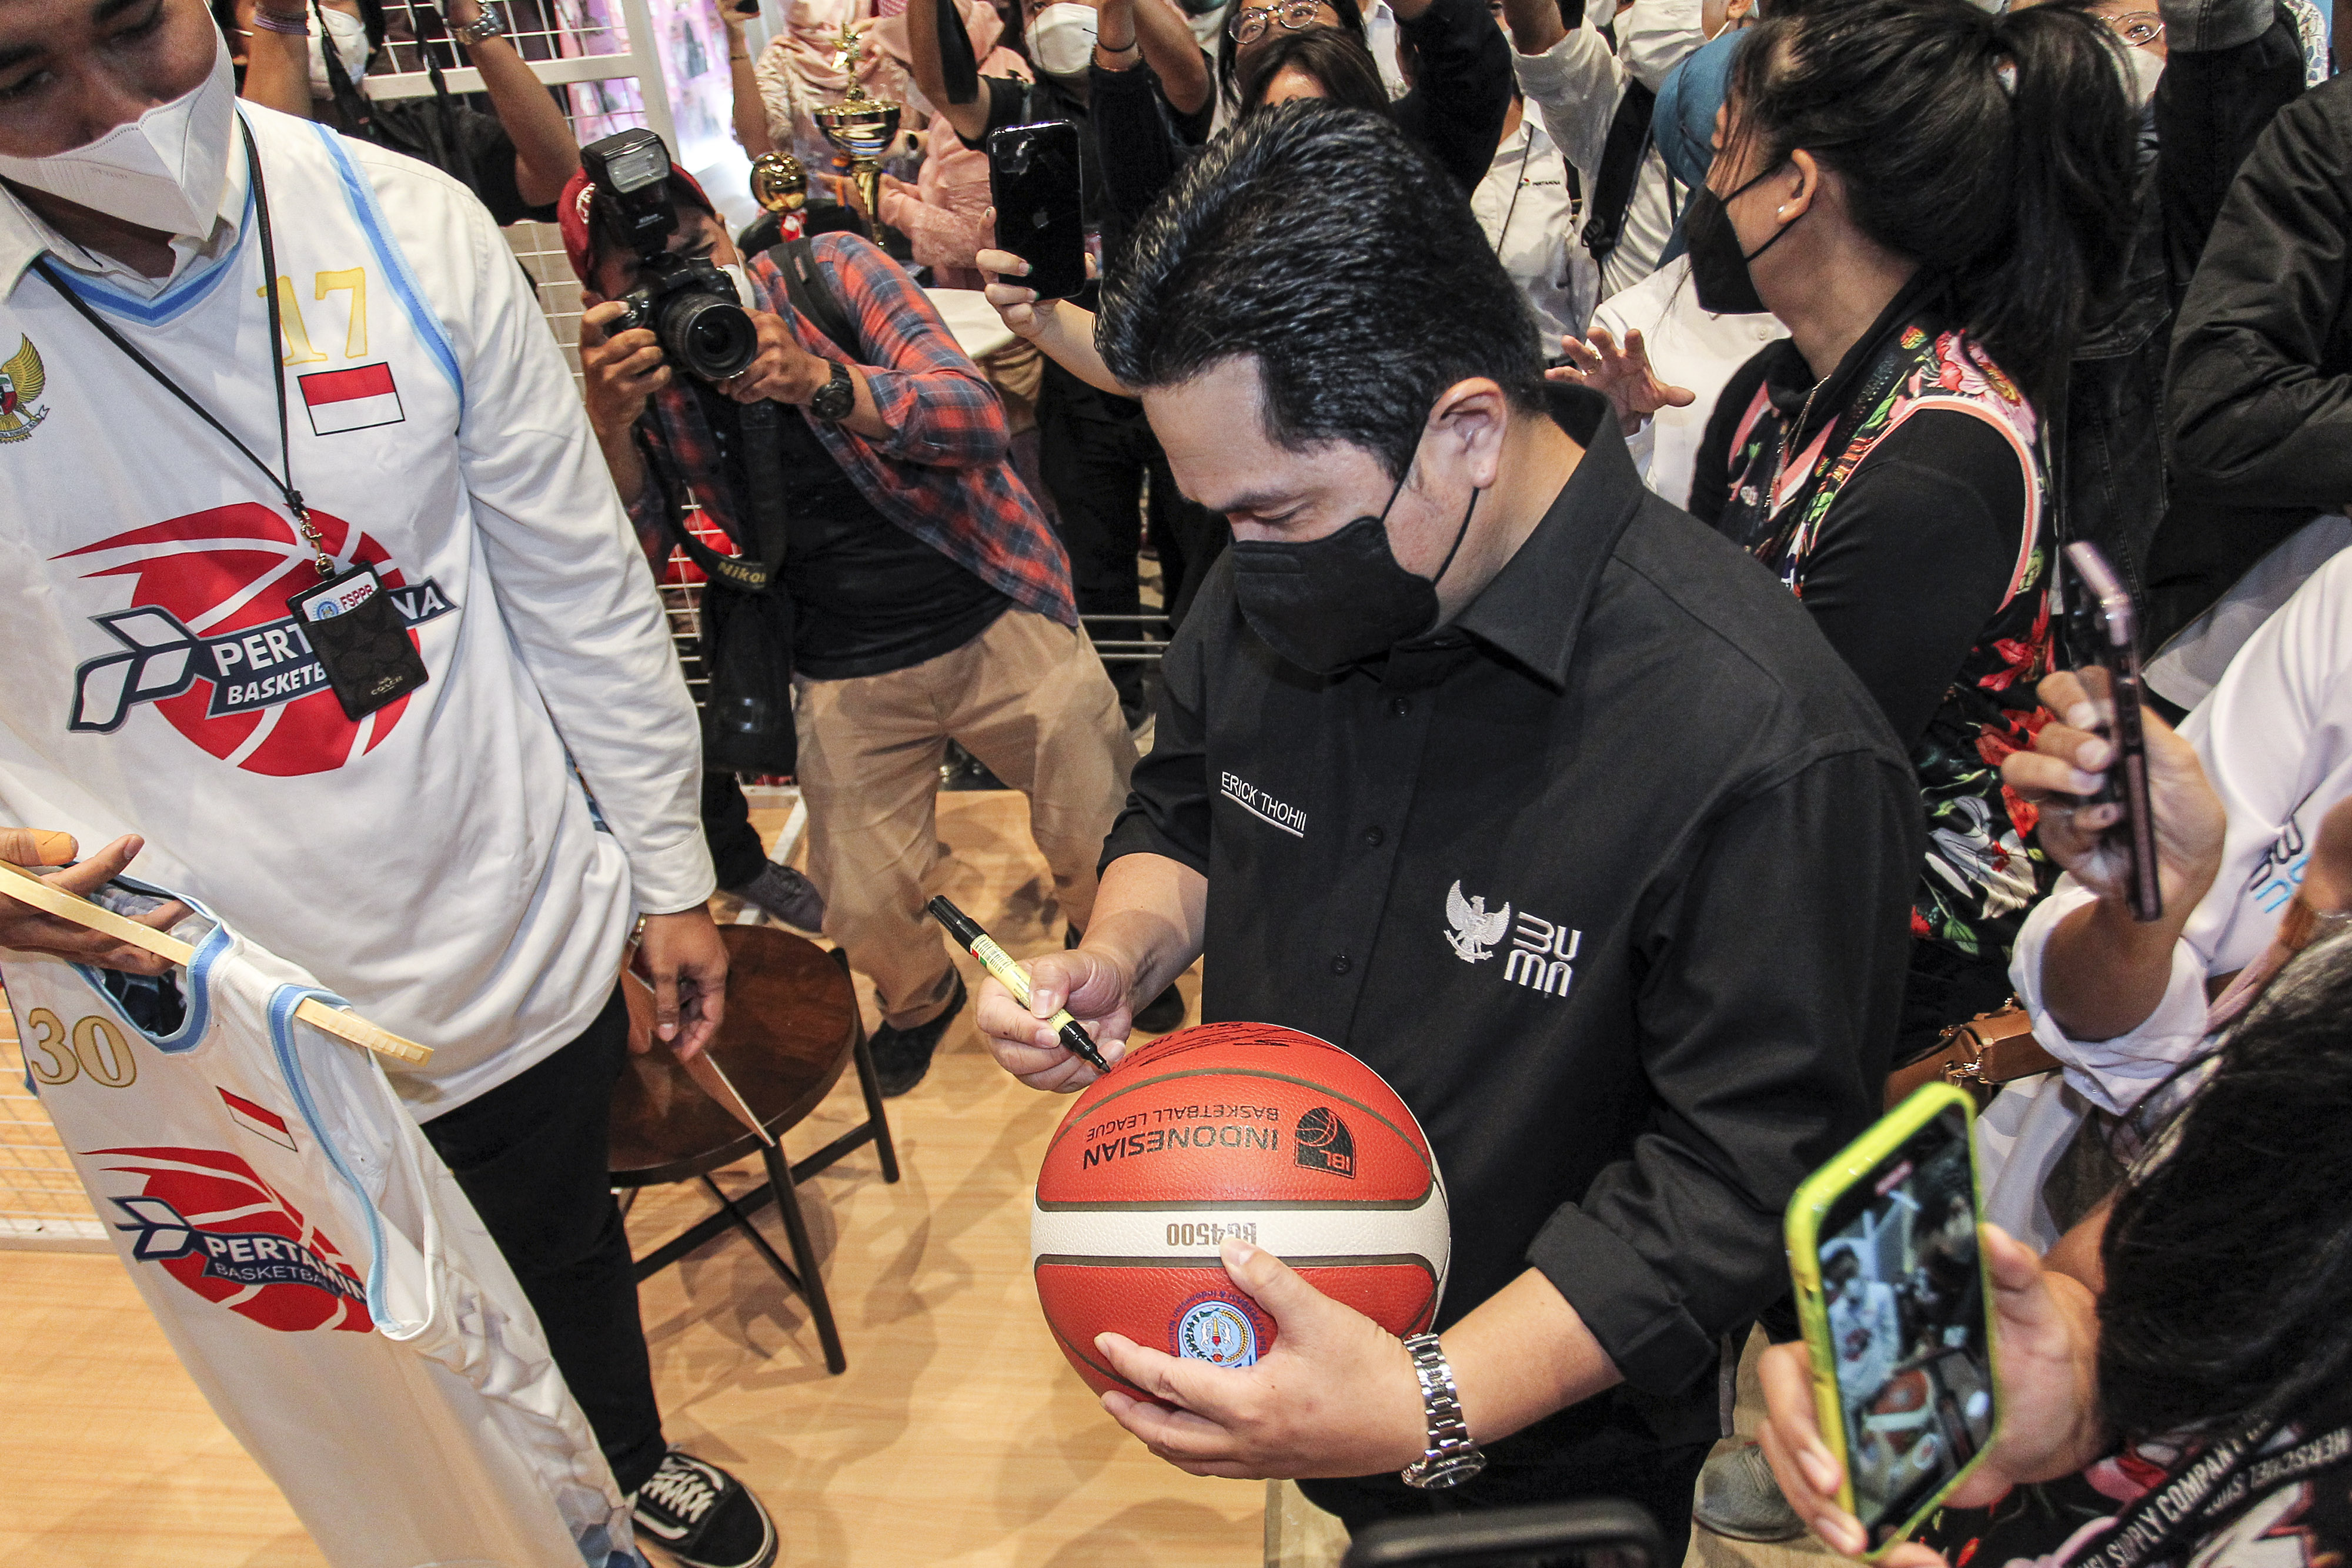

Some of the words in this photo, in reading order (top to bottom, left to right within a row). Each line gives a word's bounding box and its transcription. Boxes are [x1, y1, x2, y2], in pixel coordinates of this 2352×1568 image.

[256, 267, 368, 367] 17
[228, 662, 327, 705] BASKETB
[1221, 771, 1258, 805] ERICK
[29, 1008, 136, 1088] 30
[1087, 1112, 1147, 1141] LEAGUE
[1152, 1104, 1279, 1126] BASKETBALL
[1083, 1125, 1278, 1169] INDONESIAN
[1318, 1149, 1351, 1171] IBL
[1167, 1223, 1257, 1246] BG4500
[203, 1236, 366, 1299] PERTAMIN
[1172, 1290, 1217, 1318] Indonesian
[1168, 1319, 1177, 1354] Nationa
